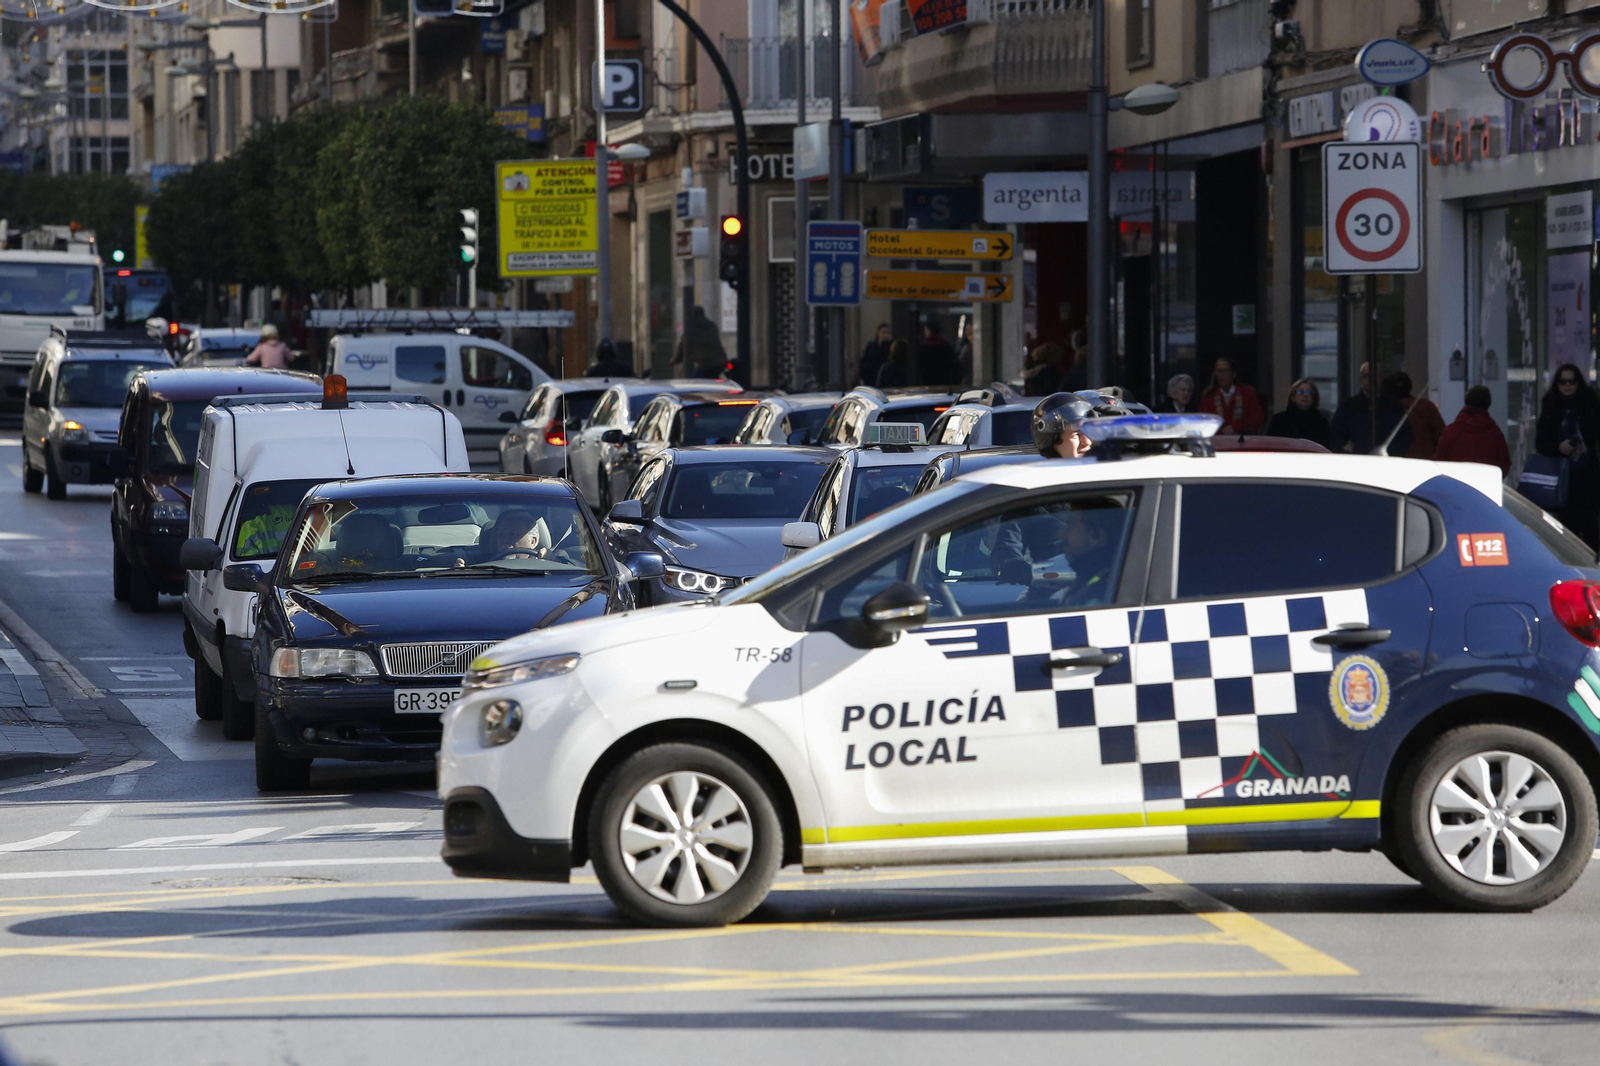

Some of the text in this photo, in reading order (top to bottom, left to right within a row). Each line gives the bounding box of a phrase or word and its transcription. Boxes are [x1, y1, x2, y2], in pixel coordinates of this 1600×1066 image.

[603, 65, 634, 107] P
[1429, 110, 1490, 166] Clara
[1338, 152, 1406, 170] ZONA
[536, 165, 596, 177] ATENCIÓN
[535, 186, 596, 196] POR CÁMARA
[993, 185, 1081, 211] argenta
[1354, 213, 1393, 236] 30
[514, 228, 553, 238] TRÁFICO
[869, 234, 900, 243] Hotel
[814, 241, 854, 250] MOTOS
[869, 245, 966, 255] Occidental Granada
[871, 285, 903, 294] Corona
[907, 286, 917, 294] de
[882, 426, 907, 441] TAXI
[1475, 539, 1502, 552] 112
[734, 647, 792, 663] TR-58
[842, 689, 1006, 733] POLICÍA
[845, 736, 978, 771] LOCAL
[1235, 774, 1351, 798] GRANADA
